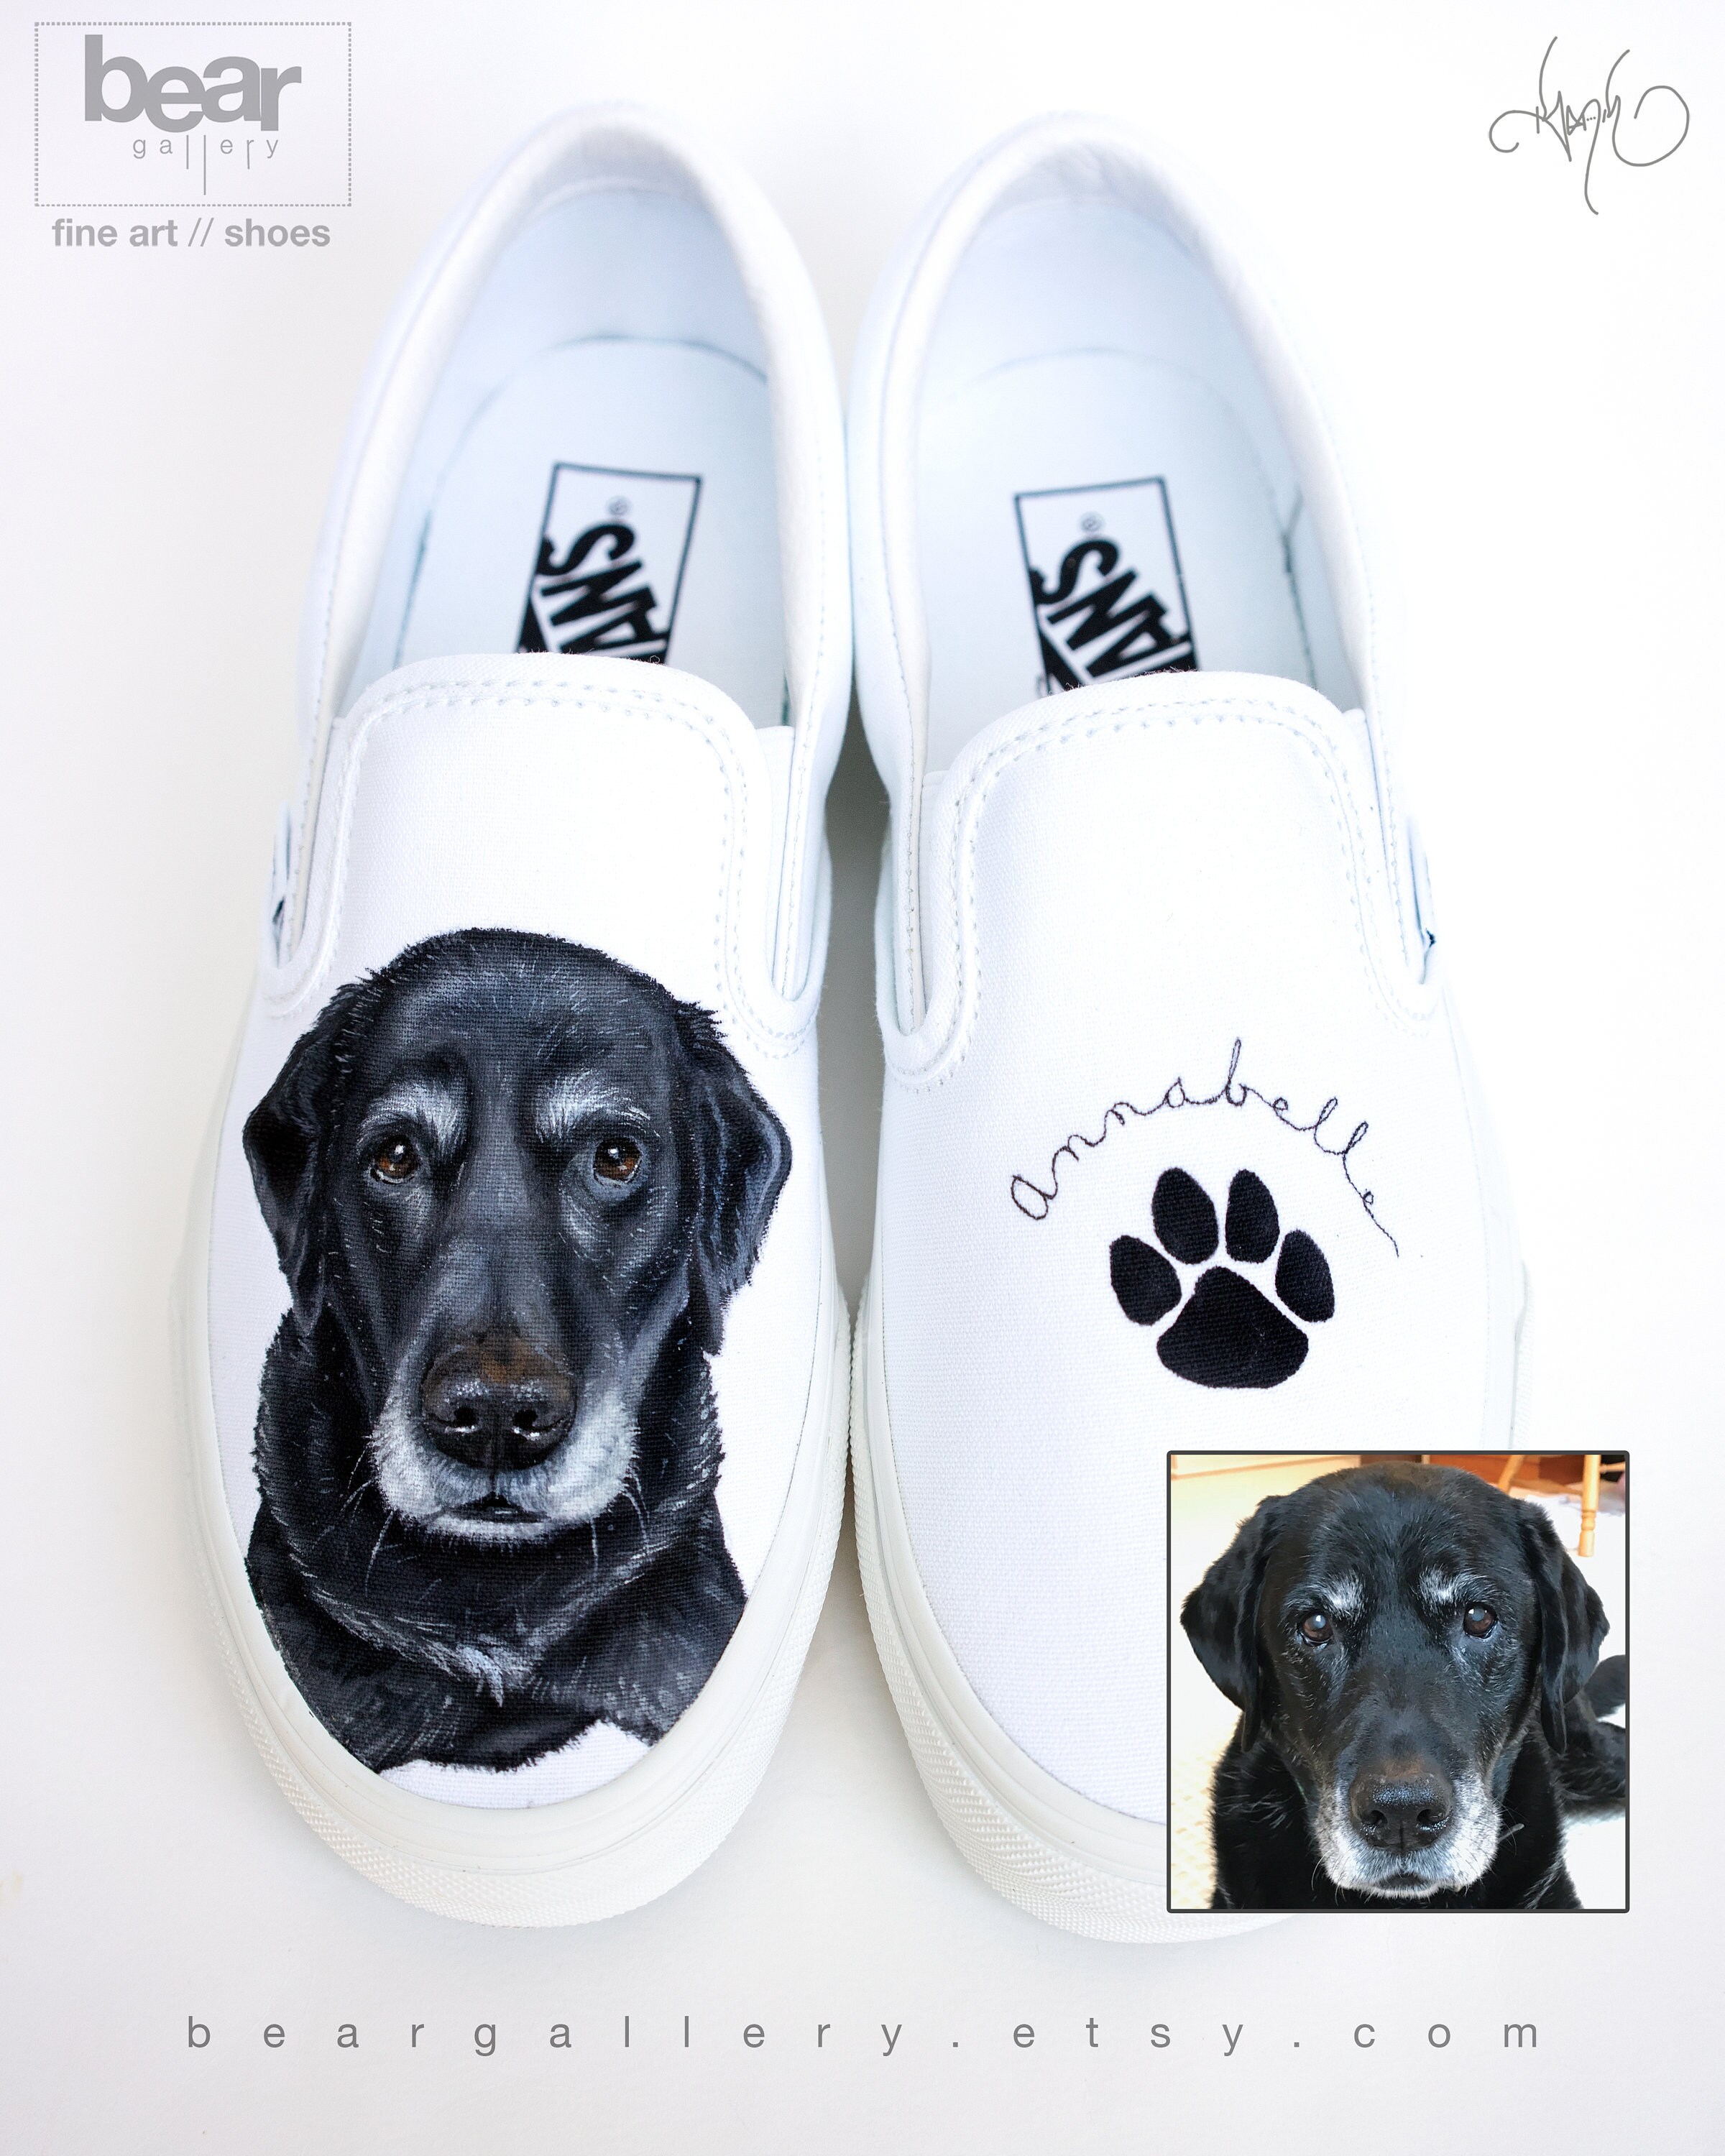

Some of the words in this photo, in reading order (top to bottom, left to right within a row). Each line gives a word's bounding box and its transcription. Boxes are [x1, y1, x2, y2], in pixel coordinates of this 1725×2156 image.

[518, 521, 670, 663] ANS
[1029, 539, 1198, 690] ANS
[1010, 1037, 1400, 1258] annabelle
